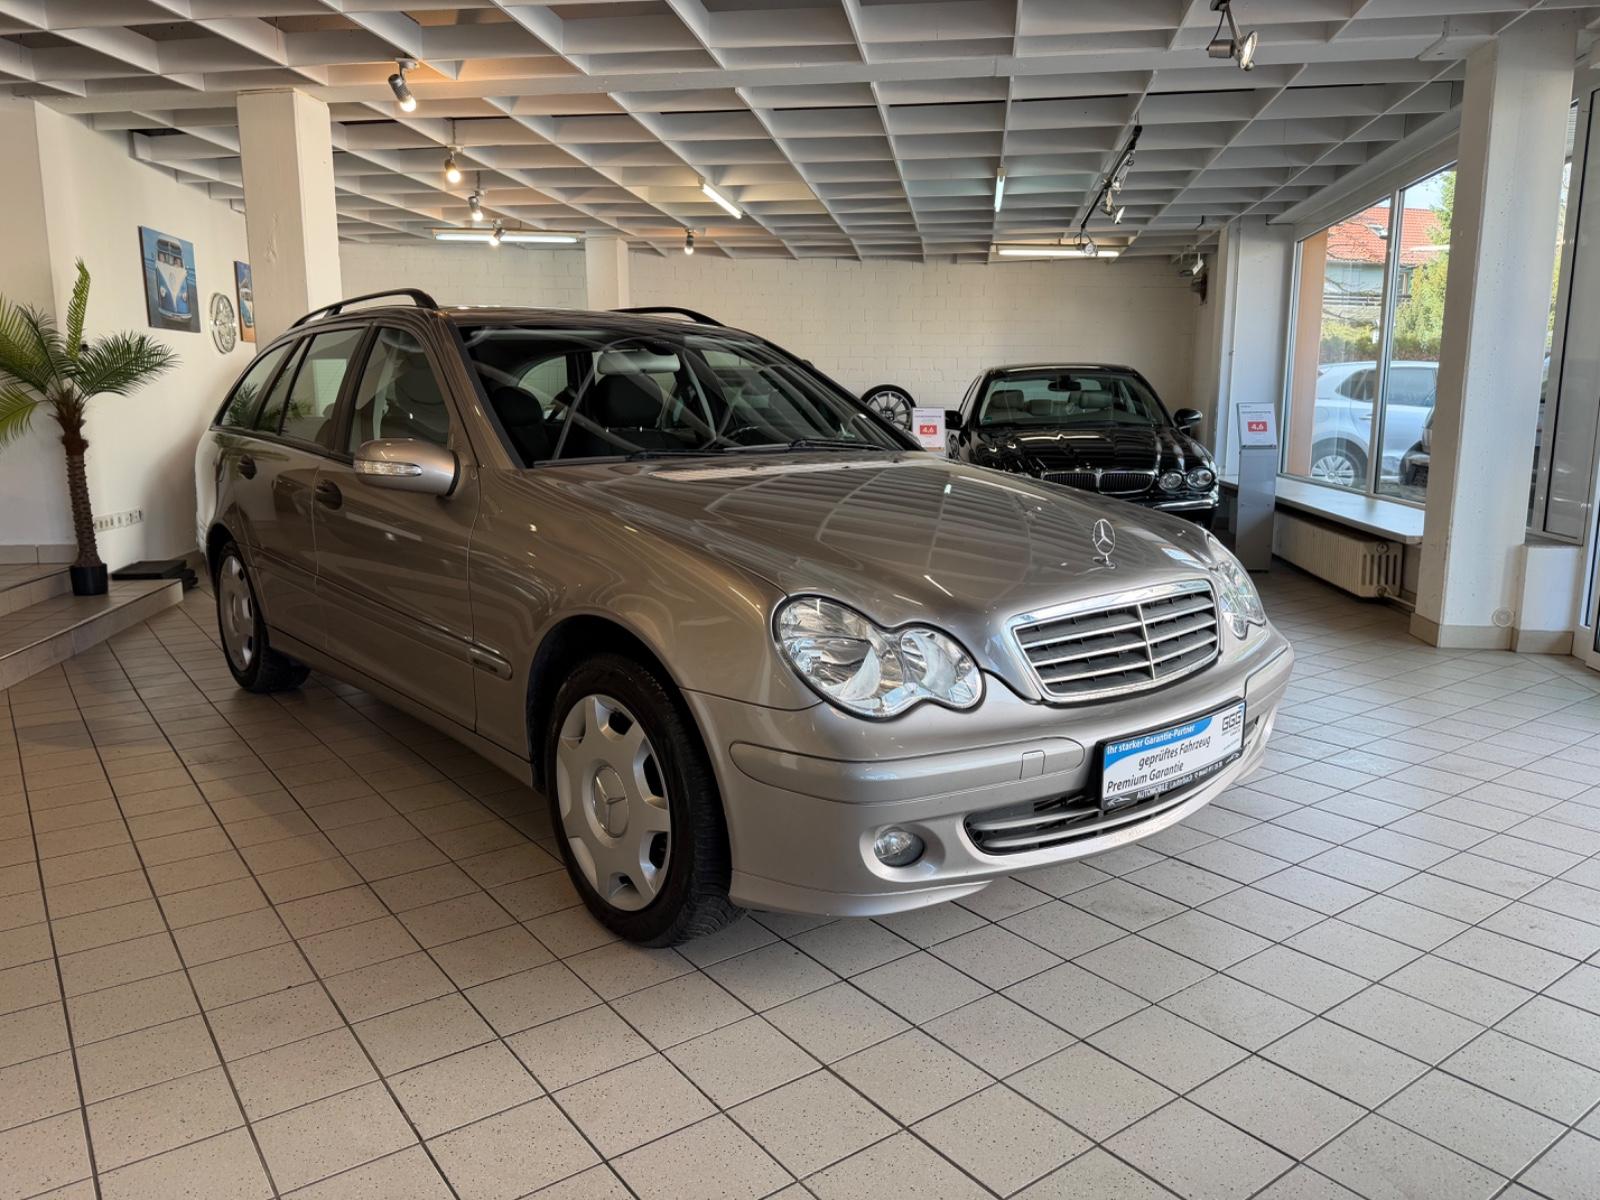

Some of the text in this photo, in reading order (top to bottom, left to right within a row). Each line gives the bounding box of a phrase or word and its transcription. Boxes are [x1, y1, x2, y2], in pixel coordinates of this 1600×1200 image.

[1222, 710, 1242, 731] GGG
[1107, 724, 1195, 754] Ihr starker Garantie-Partner
[1138, 747, 1177, 770] geprüftes
[1179, 735, 1211, 755] Fahrzeug
[1106, 771, 1147, 793] Premium
[1149, 761, 1184, 781] Garantie
